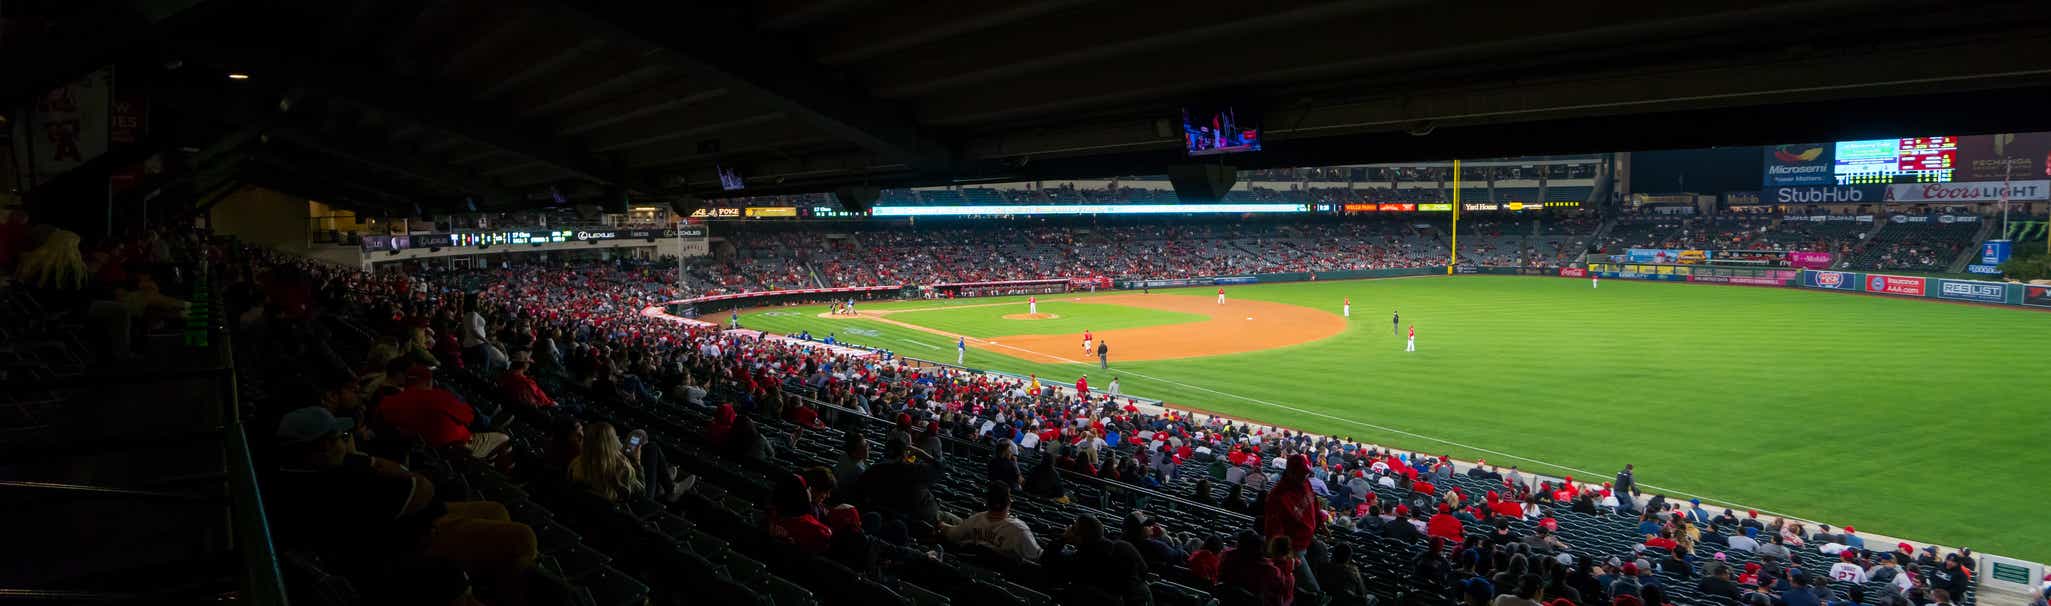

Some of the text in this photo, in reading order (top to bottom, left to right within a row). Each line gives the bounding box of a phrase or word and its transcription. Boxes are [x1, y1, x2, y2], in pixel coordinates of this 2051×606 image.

[1769, 163, 1828, 175] Microsemi
[1778, 187, 1863, 203] StubHub
[1923, 183, 1981, 199] Coors
[1983, 186, 2037, 198] LIGHT
[1465, 203, 1479, 211] Yard
[1480, 203, 1498, 211] House
[1888, 286, 1919, 294] AAA.com
[1839, 571, 1856, 581] 27
